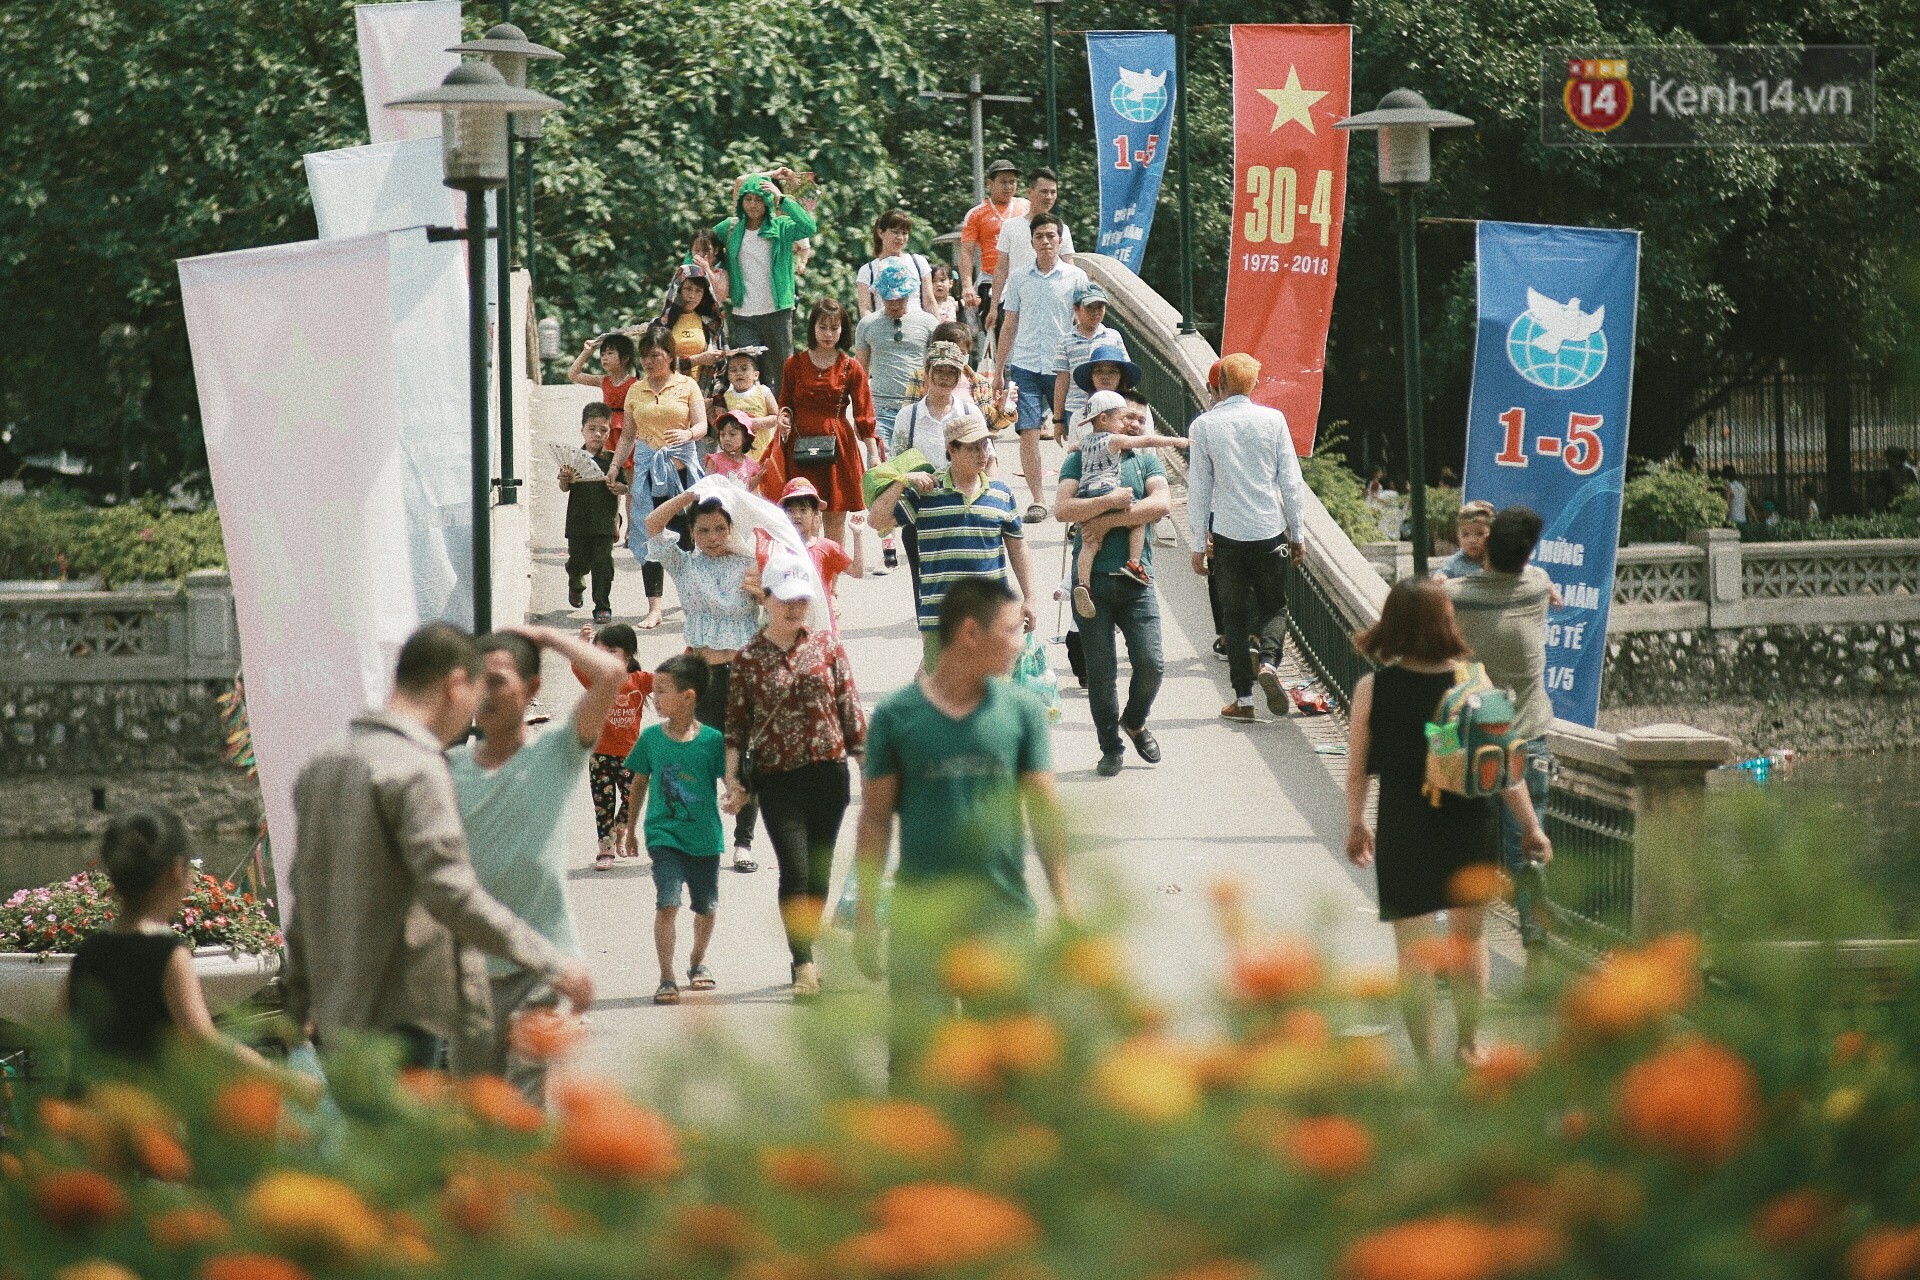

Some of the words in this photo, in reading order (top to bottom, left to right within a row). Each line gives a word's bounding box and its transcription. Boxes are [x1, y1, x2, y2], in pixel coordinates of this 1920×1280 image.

[1244, 165, 1333, 247] 30-4
[1242, 253, 1279, 273] 1975
[1291, 254, 1329, 276] 2018
[1495, 406, 1604, 476] 1-5
[1538, 536, 1585, 567] MỪNG
[1564, 582, 1600, 610] NĂM
[1563, 621, 1588, 650] TẾ
[1547, 666, 1575, 691] 1/5
